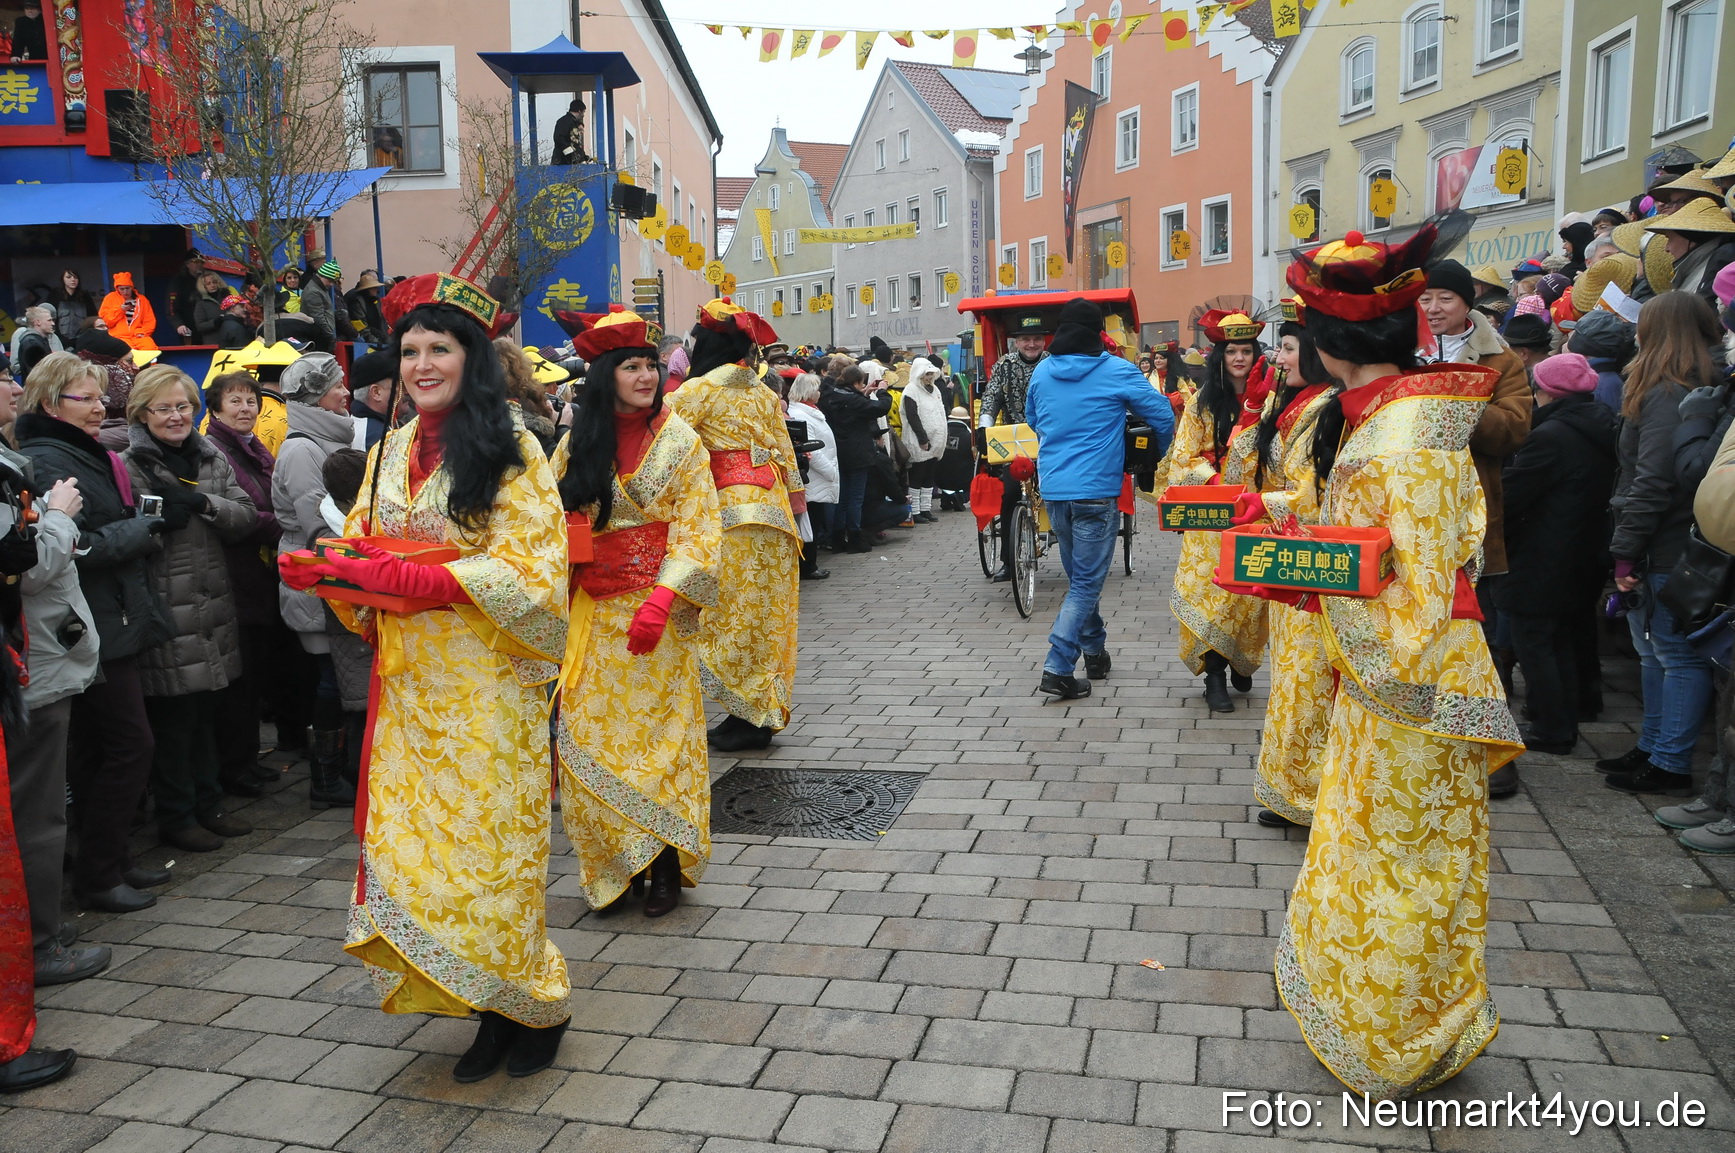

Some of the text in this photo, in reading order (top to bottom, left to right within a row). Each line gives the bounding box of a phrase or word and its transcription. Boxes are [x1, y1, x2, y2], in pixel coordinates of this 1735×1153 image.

[971, 200, 980, 298] UHREN SCHM
[866, 317, 922, 338] OPTIK OEXL
[1188, 518, 1211, 526] CHINA
[1278, 548, 1350, 572] 中国邮政
[1278, 567, 1350, 584] CHINA POST
